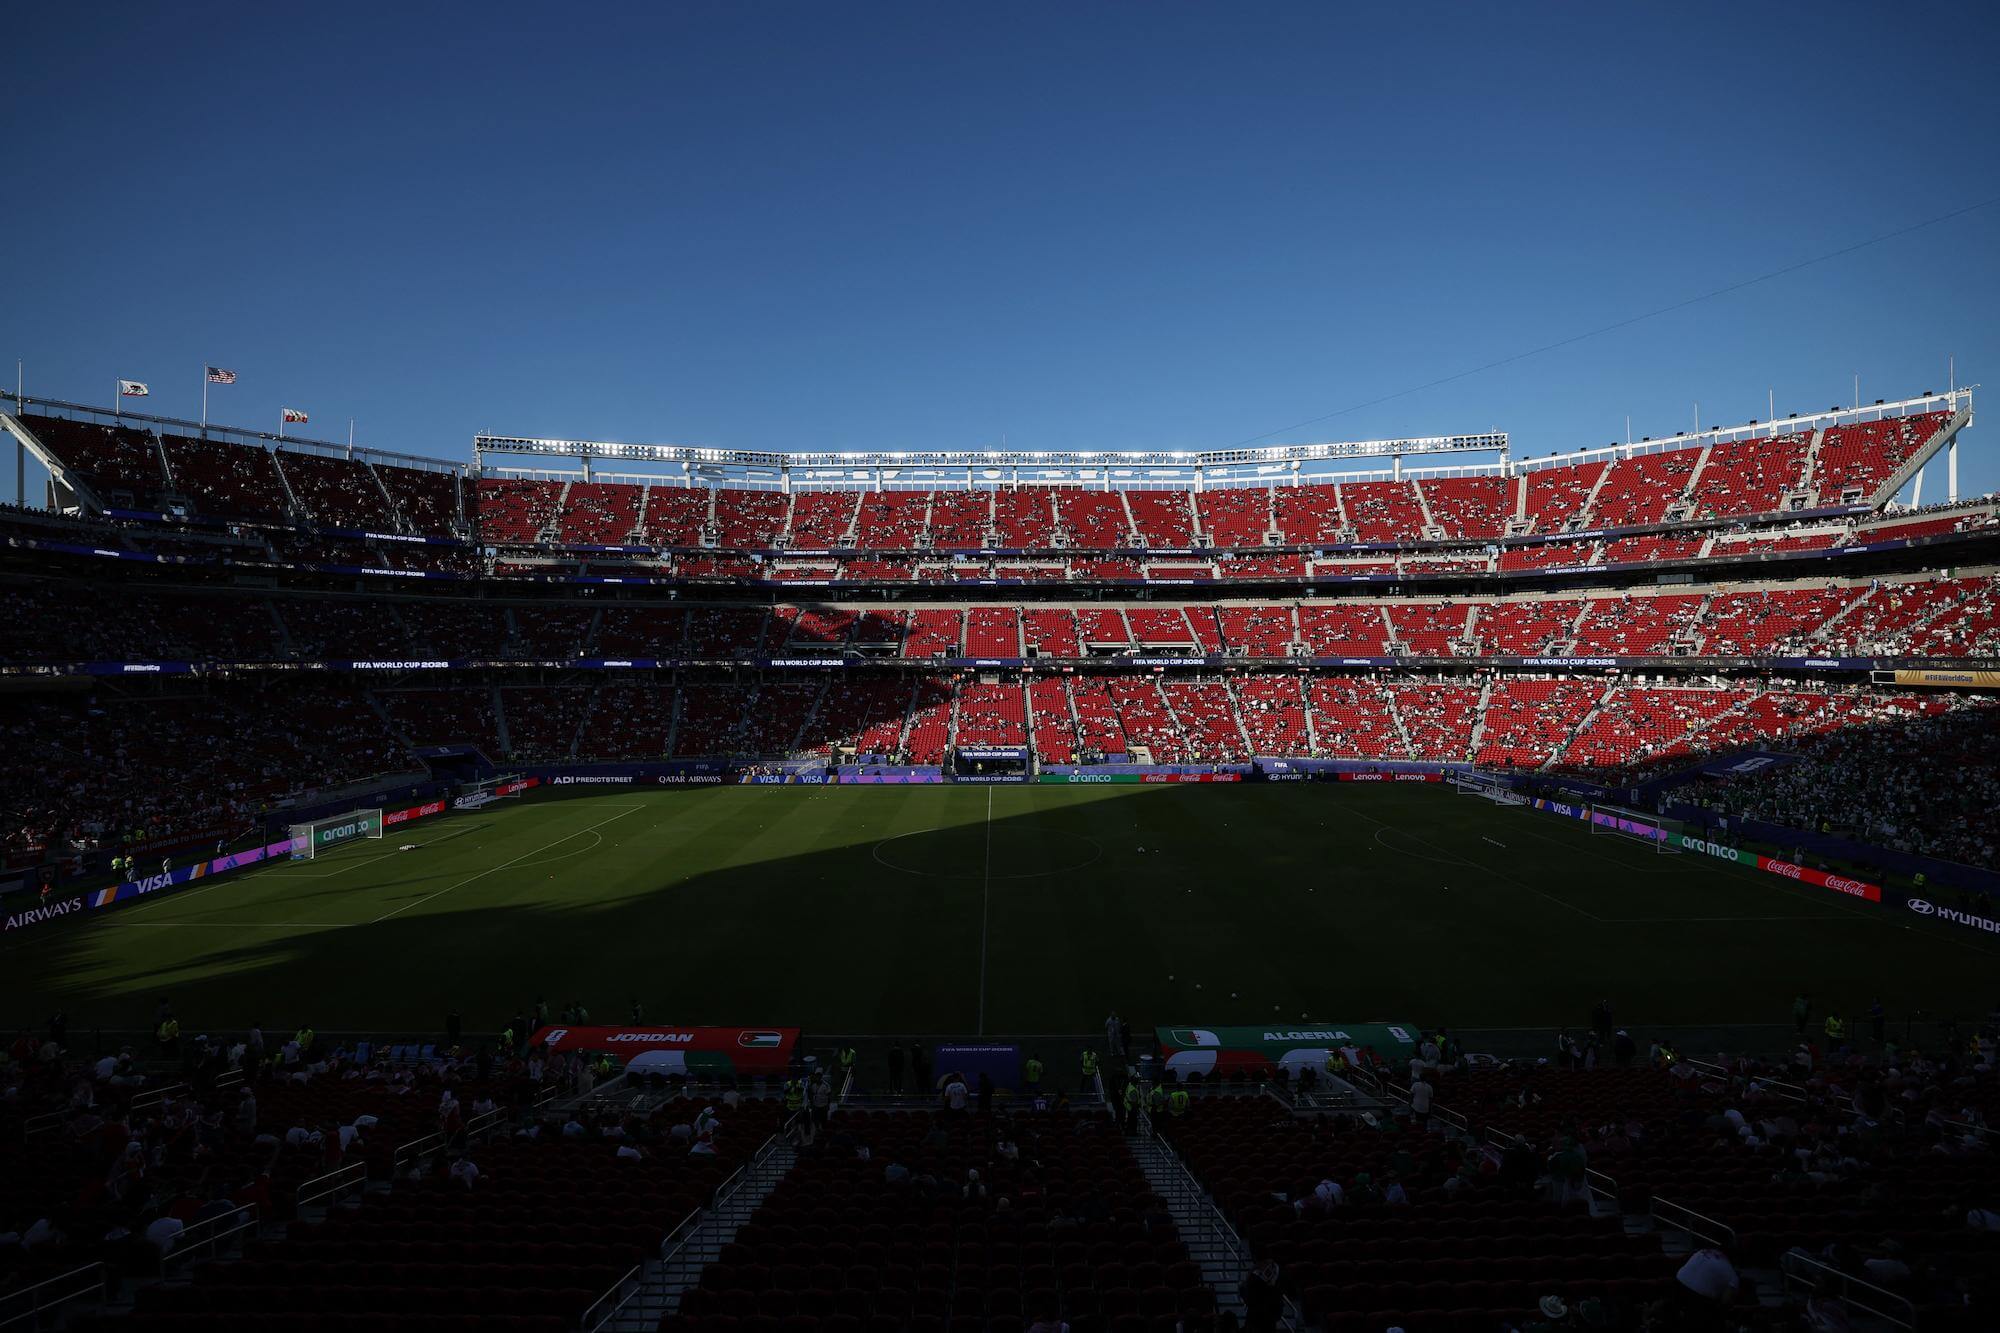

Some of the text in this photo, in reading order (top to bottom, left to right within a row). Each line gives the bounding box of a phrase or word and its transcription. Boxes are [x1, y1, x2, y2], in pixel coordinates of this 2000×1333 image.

[554, 776, 575, 784] ADI
[658, 776, 685, 784] QATAR
[1069, 774, 1111, 783] aramco
[1353, 773, 1382, 781] Lenovo
[1552, 802, 1572, 816] VISA
[1682, 836, 1738, 861] aramco
[135, 872, 174, 894] VISA
[4, 897, 82, 931] AIRWAYS
[606, 1032, 694, 1042] JORDAN
[1263, 1031, 1351, 1041] ALGERIA
